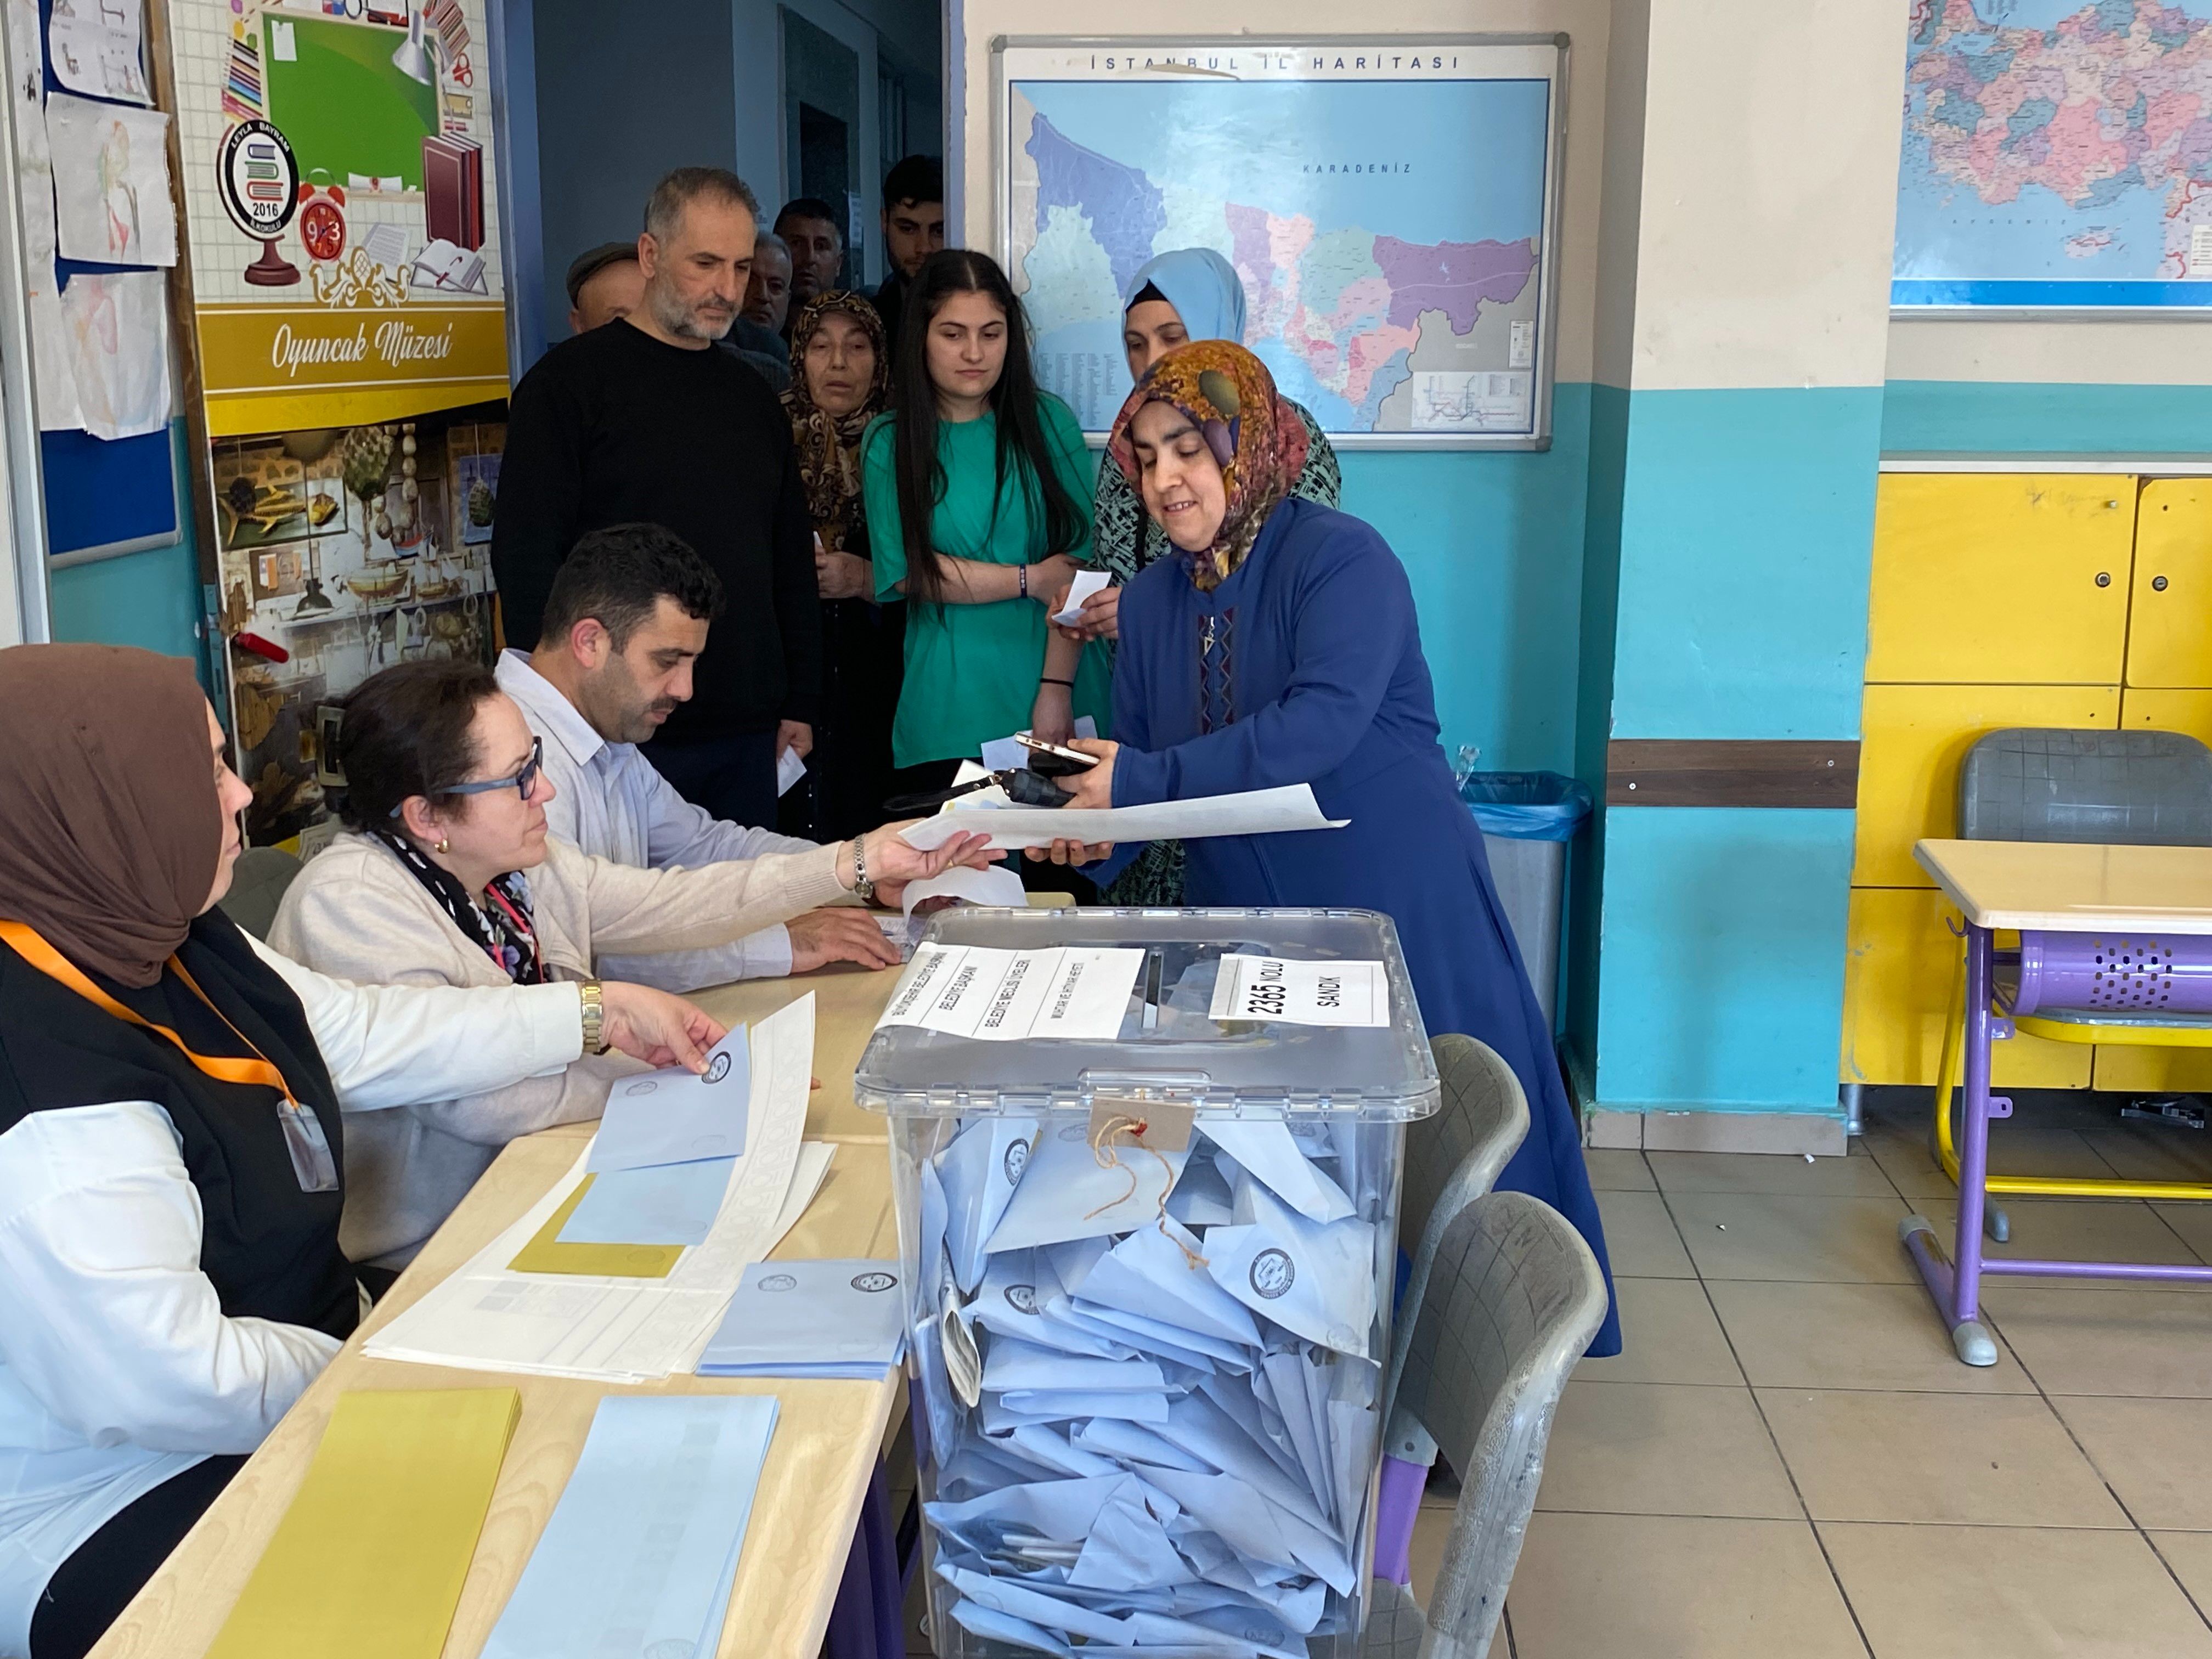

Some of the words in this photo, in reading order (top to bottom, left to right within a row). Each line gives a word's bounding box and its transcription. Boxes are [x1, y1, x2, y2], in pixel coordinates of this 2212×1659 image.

[1263, 54, 1288, 70] İL
[1313, 54, 1457, 70] HARİTASI
[230, 122, 253, 149] LEYLA
[259, 121, 290, 153] BAYRAM
[1303, 161, 1410, 173] KARADENİZ
[252, 202, 279, 217] 2016
[272, 323, 369, 377] Oyuncak
[374, 320, 453, 368] Müzesi
[1259, 961, 1284, 982] NOLU
[1247, 985, 1286, 1014] 2365
[1317, 976, 1341, 1007] SANDIK
